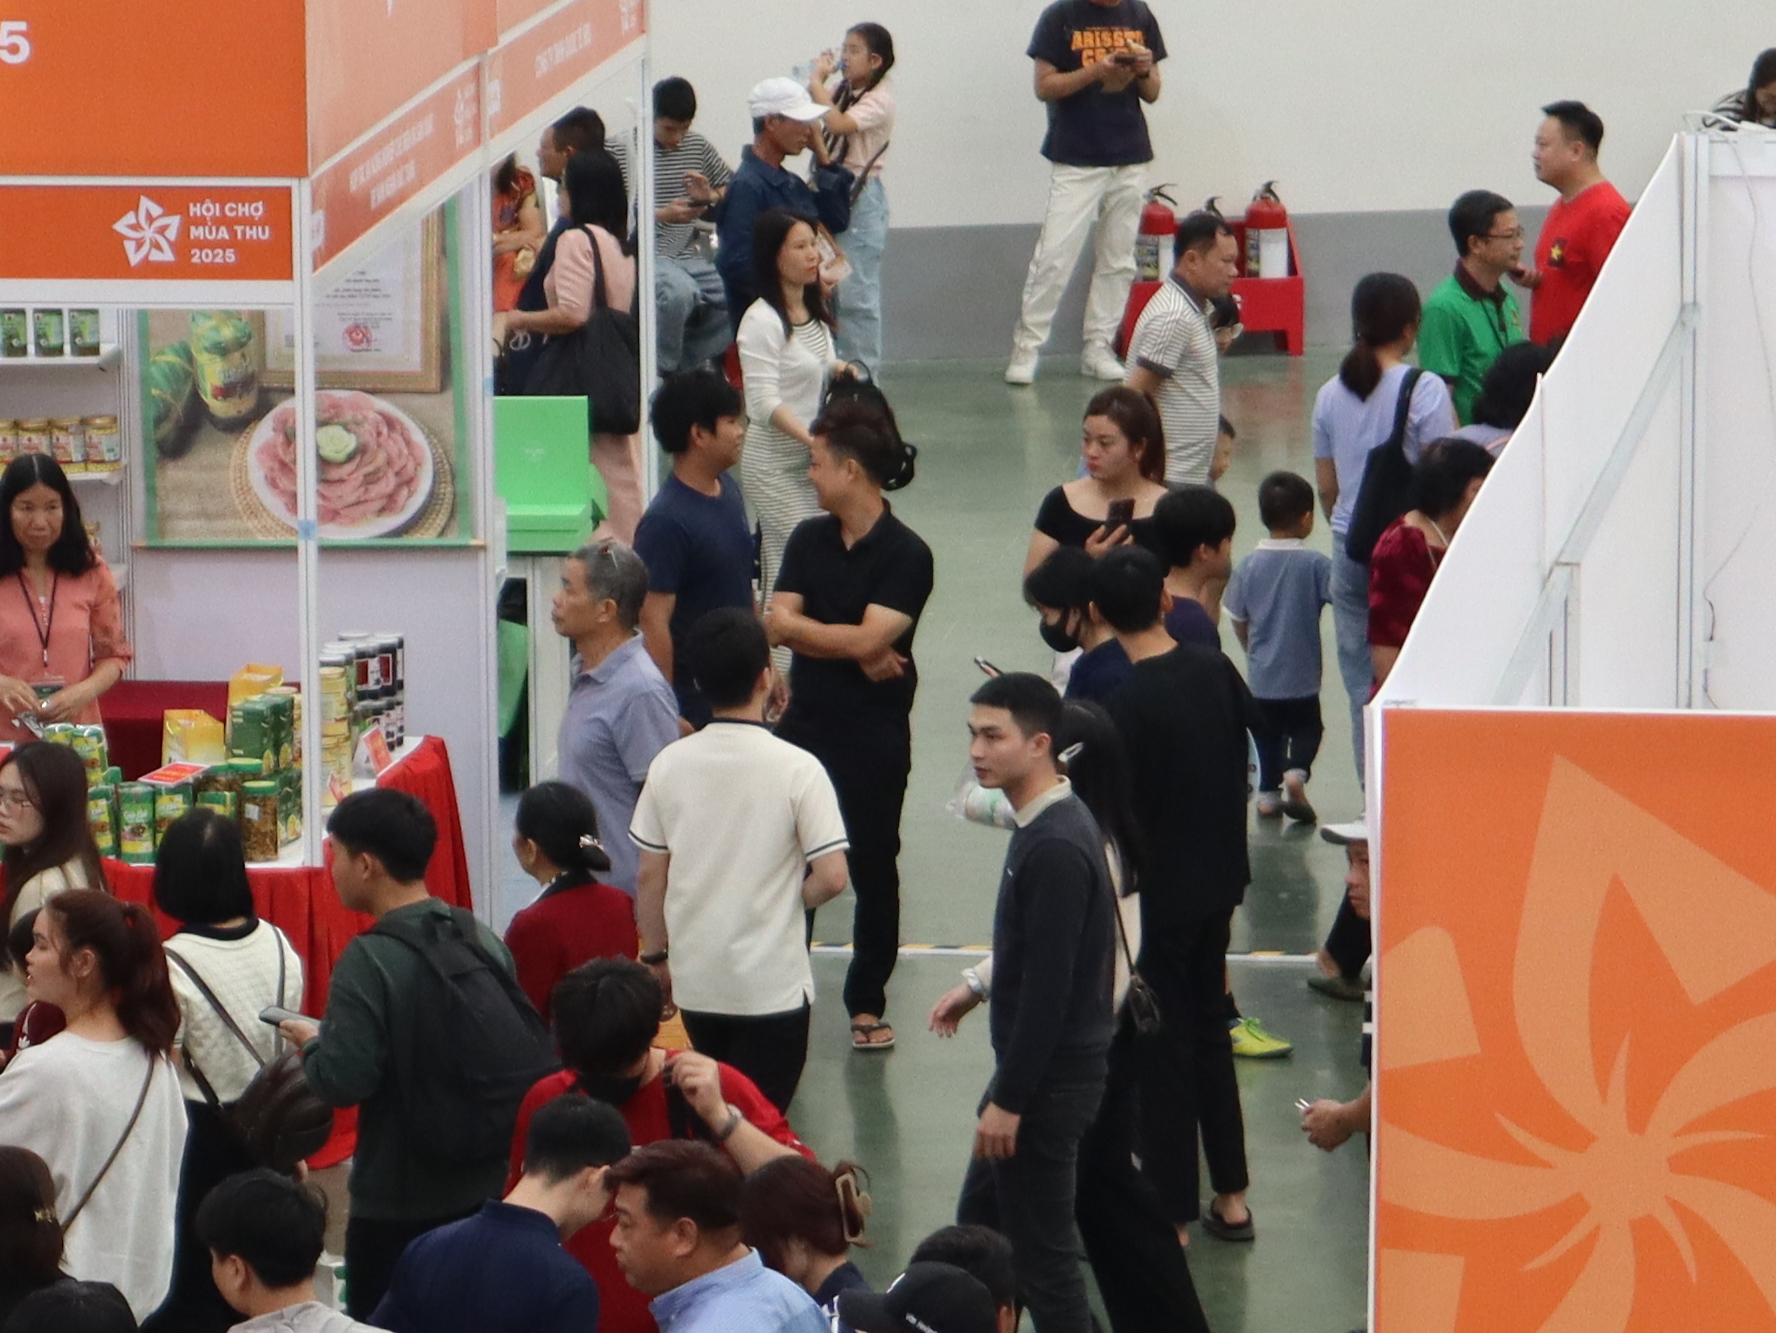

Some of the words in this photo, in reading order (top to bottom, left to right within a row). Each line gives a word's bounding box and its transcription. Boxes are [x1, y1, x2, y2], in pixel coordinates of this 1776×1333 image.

[188, 199, 220, 220] HỘI
[224, 199, 265, 220] CHỢ
[189, 222, 228, 241] MÙA
[232, 224, 270, 241] THU
[190, 248, 236, 263] 2025
